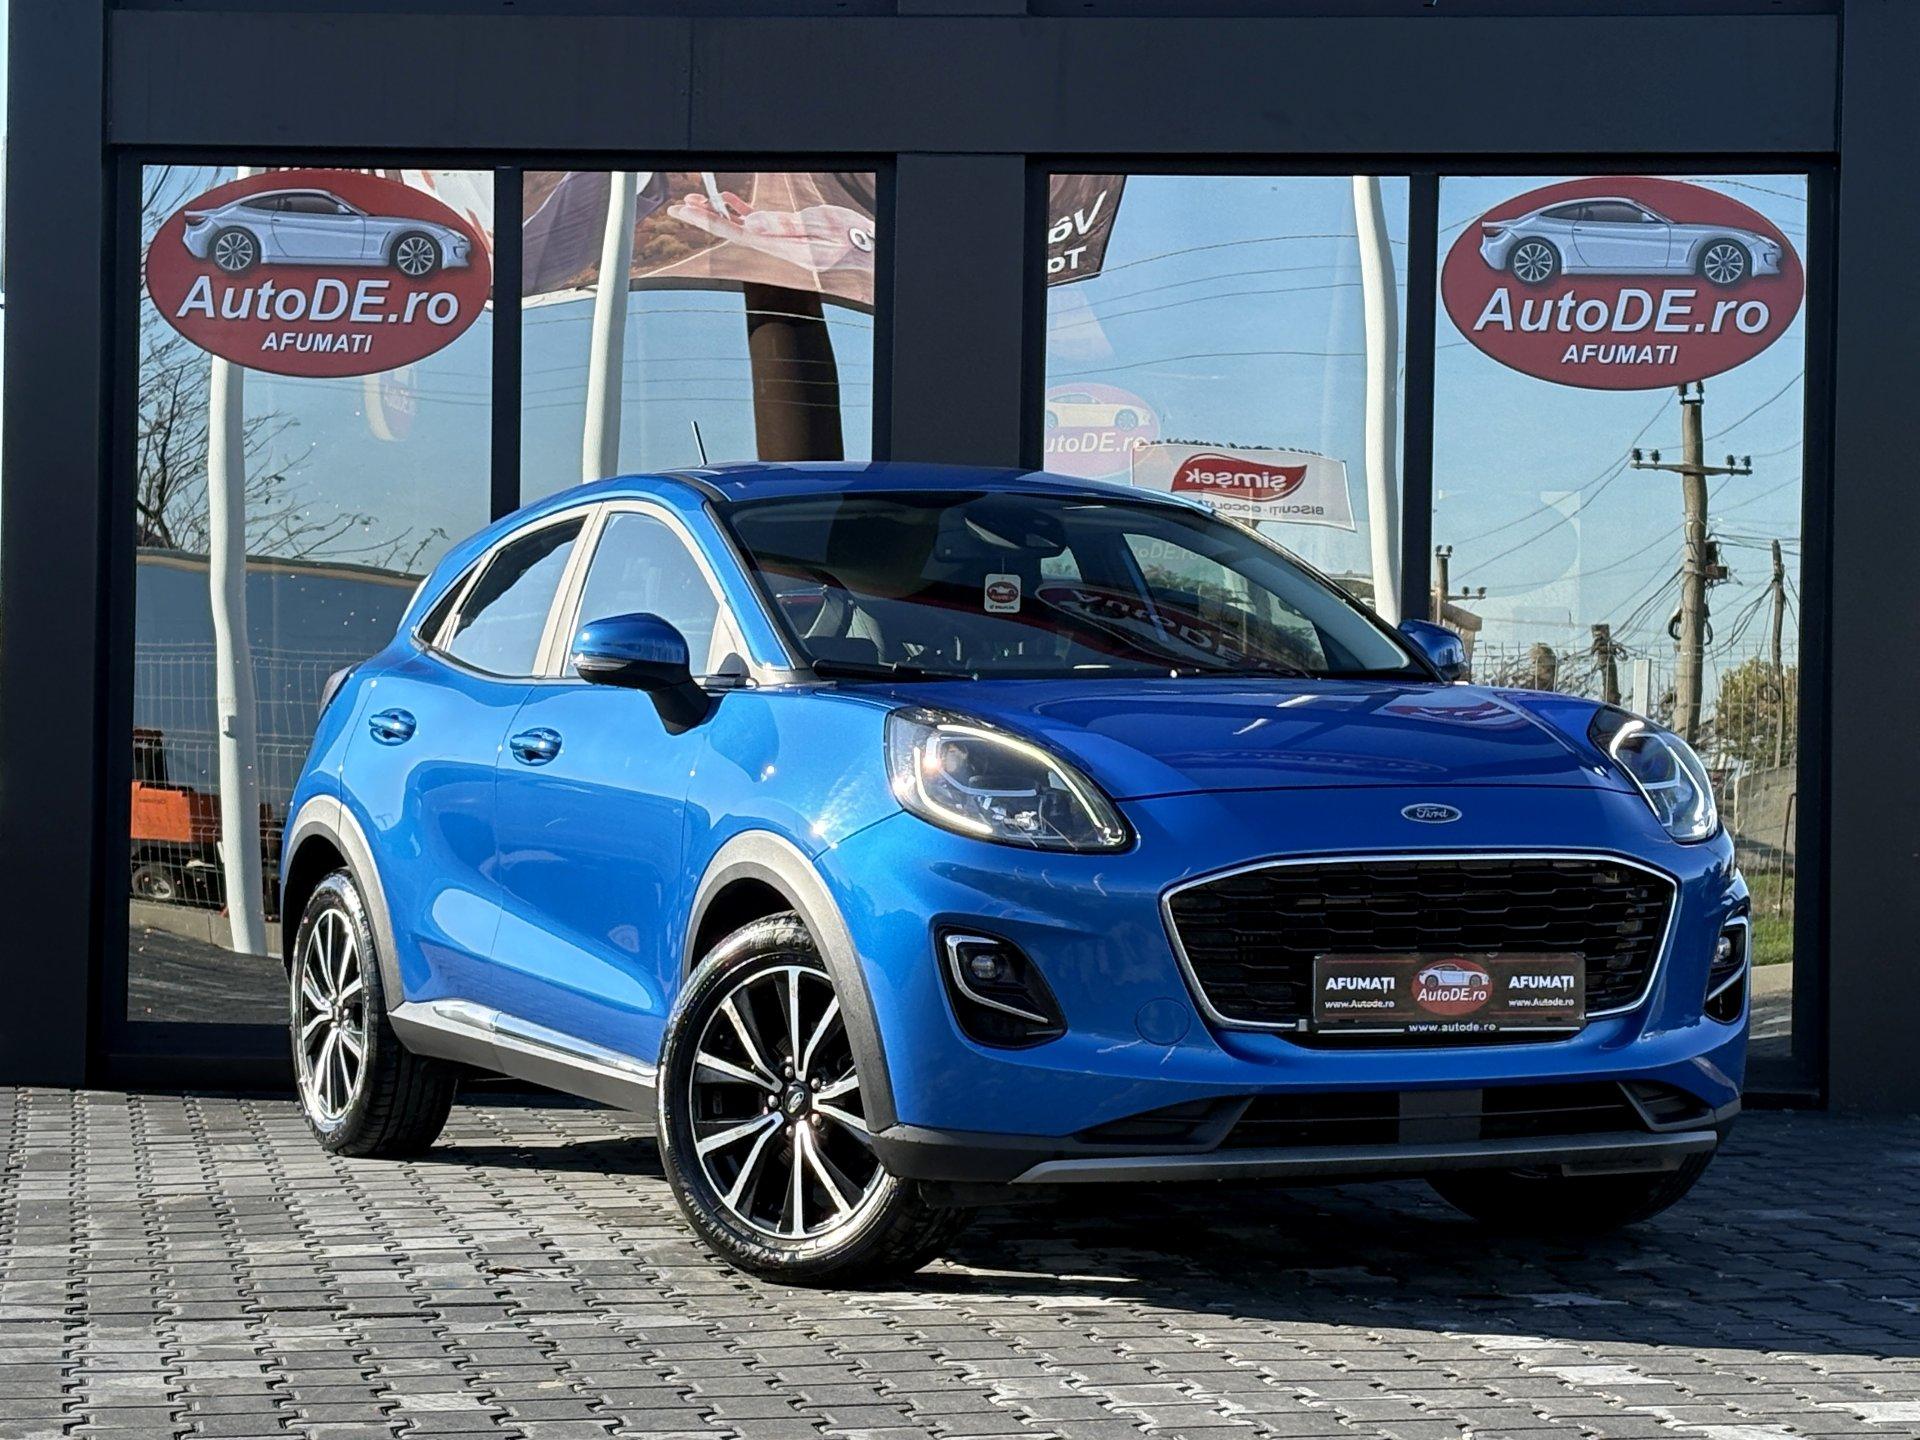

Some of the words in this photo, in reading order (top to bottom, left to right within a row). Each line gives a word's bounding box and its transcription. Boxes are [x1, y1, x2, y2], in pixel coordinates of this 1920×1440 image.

[176, 275, 459, 325] AutoDE.ro
[1473, 287, 1770, 334] AutoDE.ro
[261, 332, 373, 353] AFUMATI
[1561, 344, 1678, 365] AFUMATI
[1416, 807, 1449, 818] Ford
[1417, 988, 1488, 1002] AutoDE.ro
[1324, 1000, 1396, 1009] www.Autode.ro
[1508, 998, 1575, 1007] www.Autode.ro
[1408, 1023, 1497, 1032] www.autode.ro
